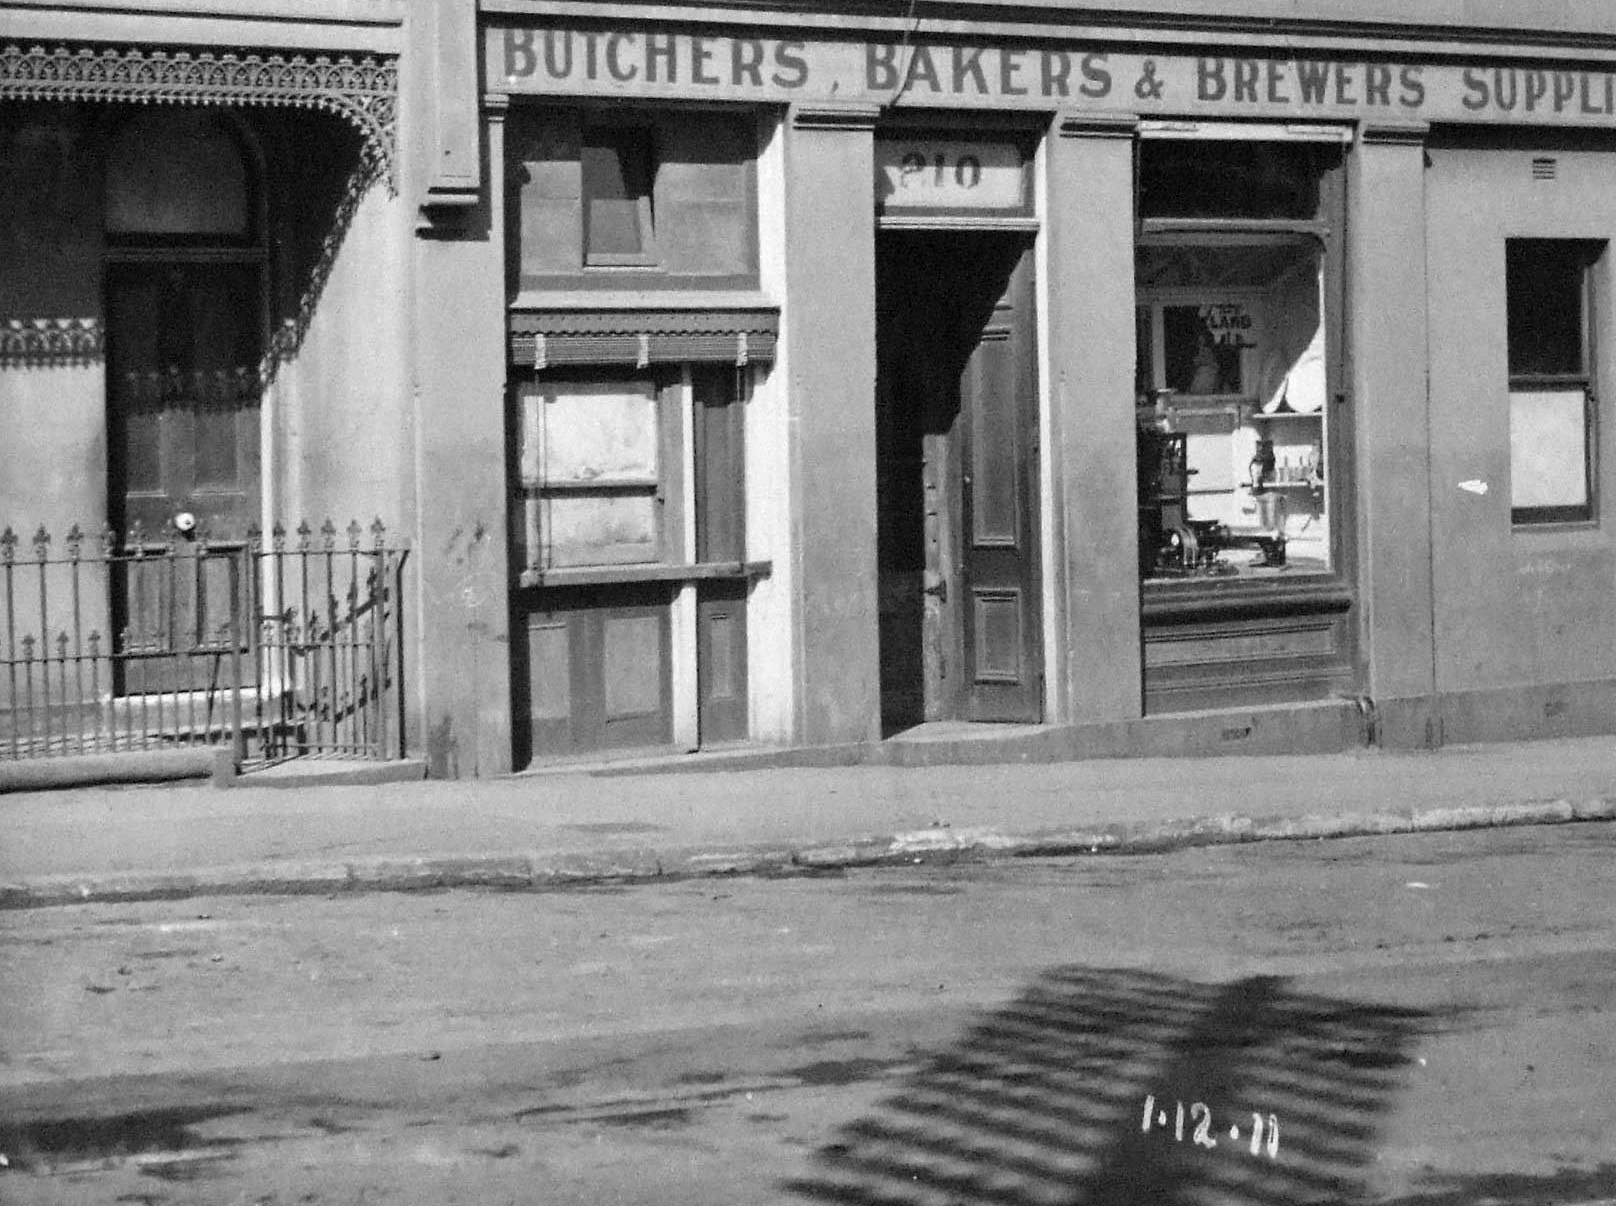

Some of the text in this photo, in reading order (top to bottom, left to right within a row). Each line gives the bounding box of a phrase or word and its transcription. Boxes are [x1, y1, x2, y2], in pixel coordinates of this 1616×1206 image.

[866, 42, 1114, 100] BAKERS
[1134, 60, 1165, 100] &
[1197, 58, 1426, 109] BREWERS
[900, 151, 982, 190] 210
